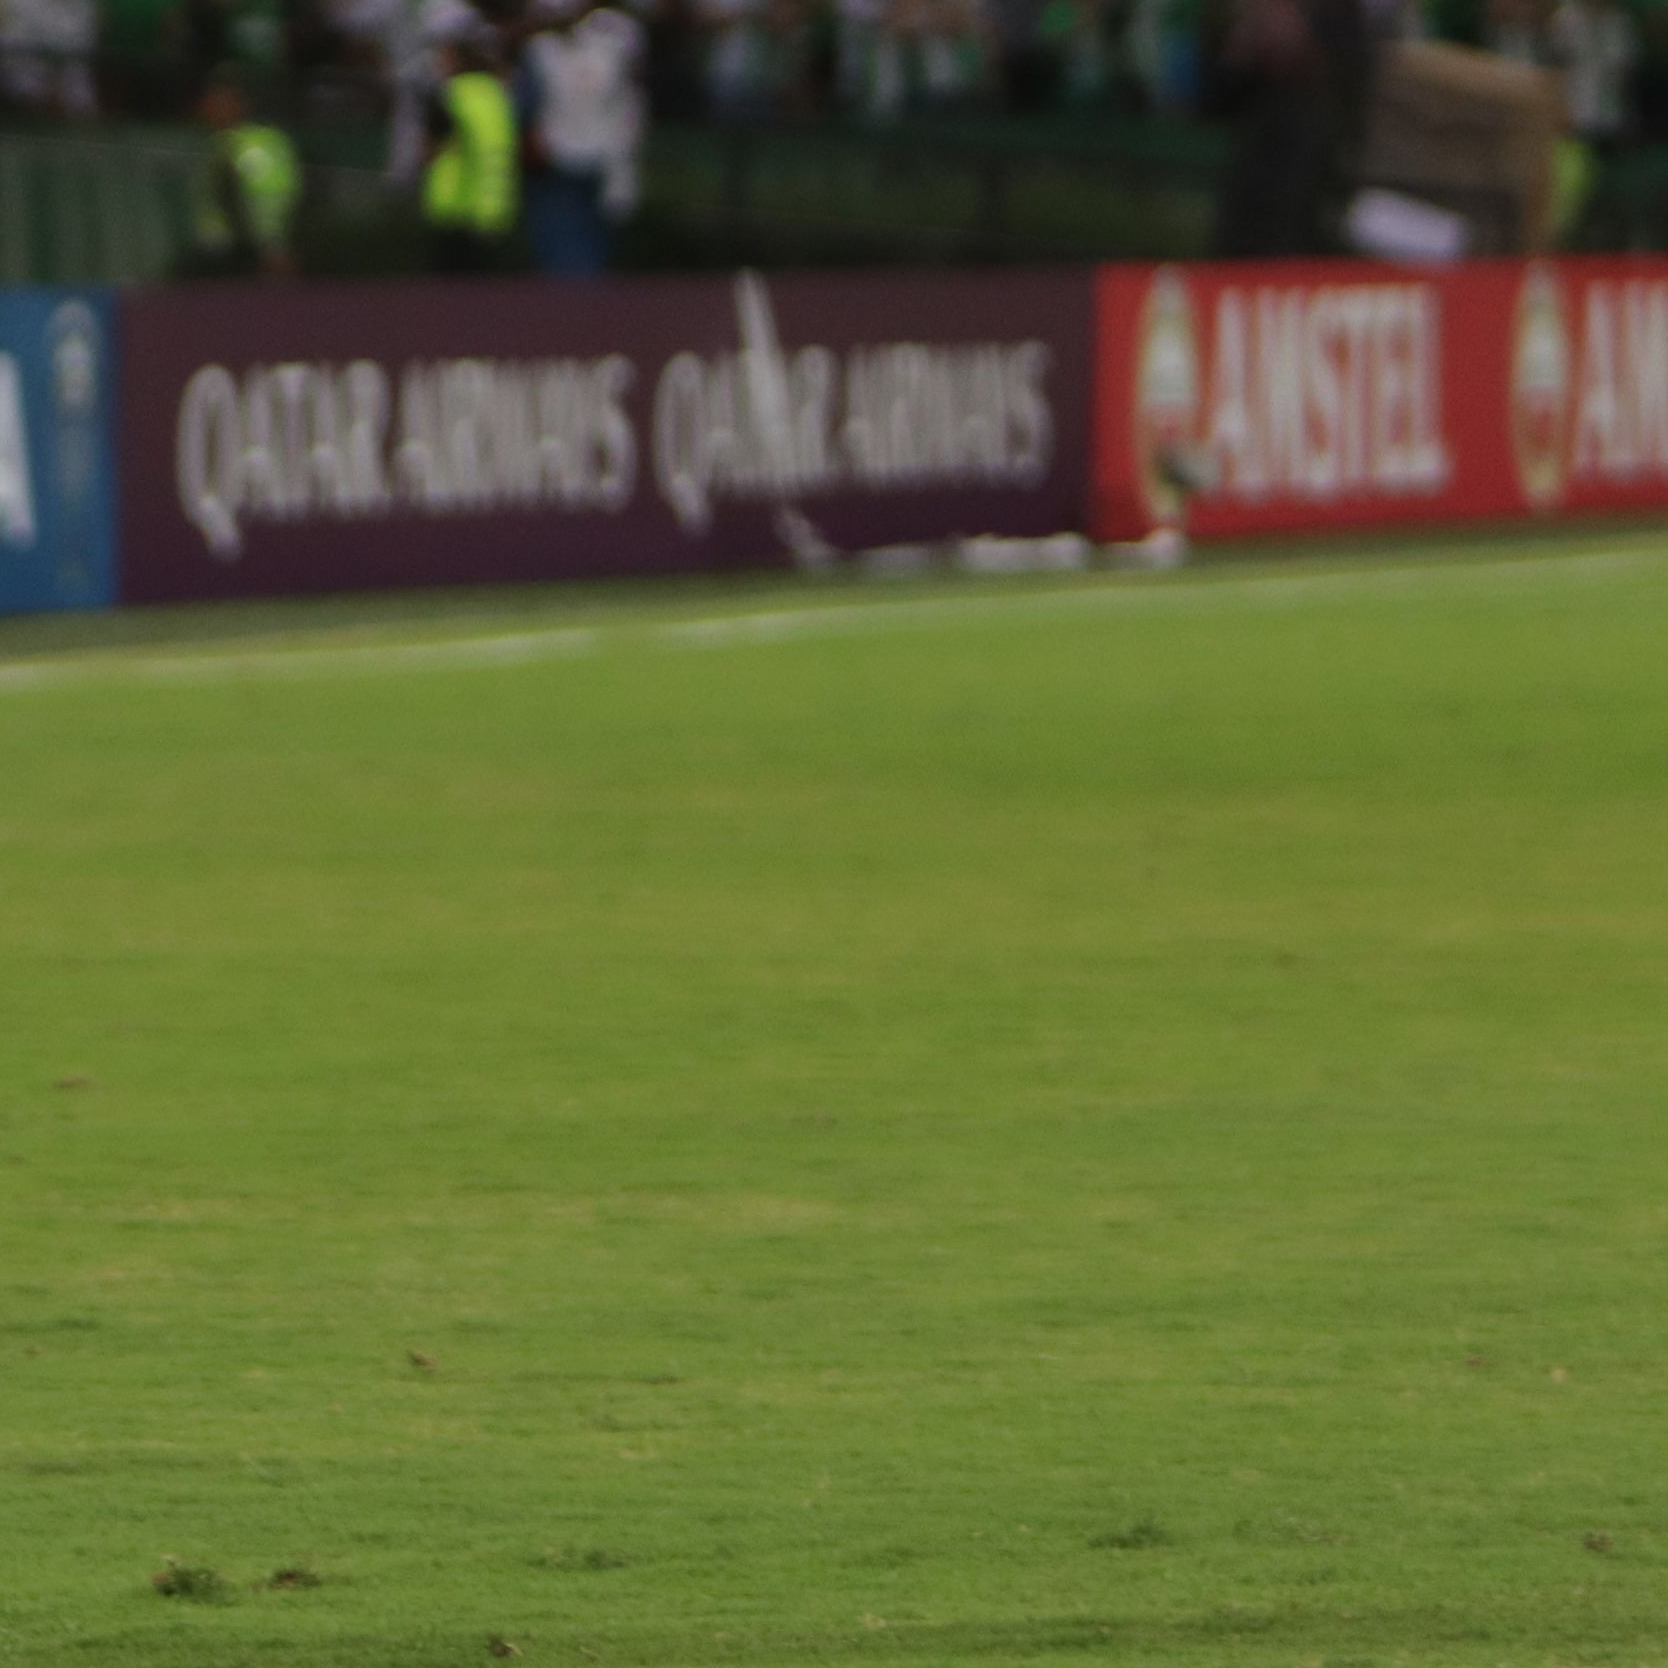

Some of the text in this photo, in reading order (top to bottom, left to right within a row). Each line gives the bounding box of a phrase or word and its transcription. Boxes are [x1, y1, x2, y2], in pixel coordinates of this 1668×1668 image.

[176, 352, 638, 561] QATAR AIRWAYS
[1209, 284, 1452, 500] AMSTEL
